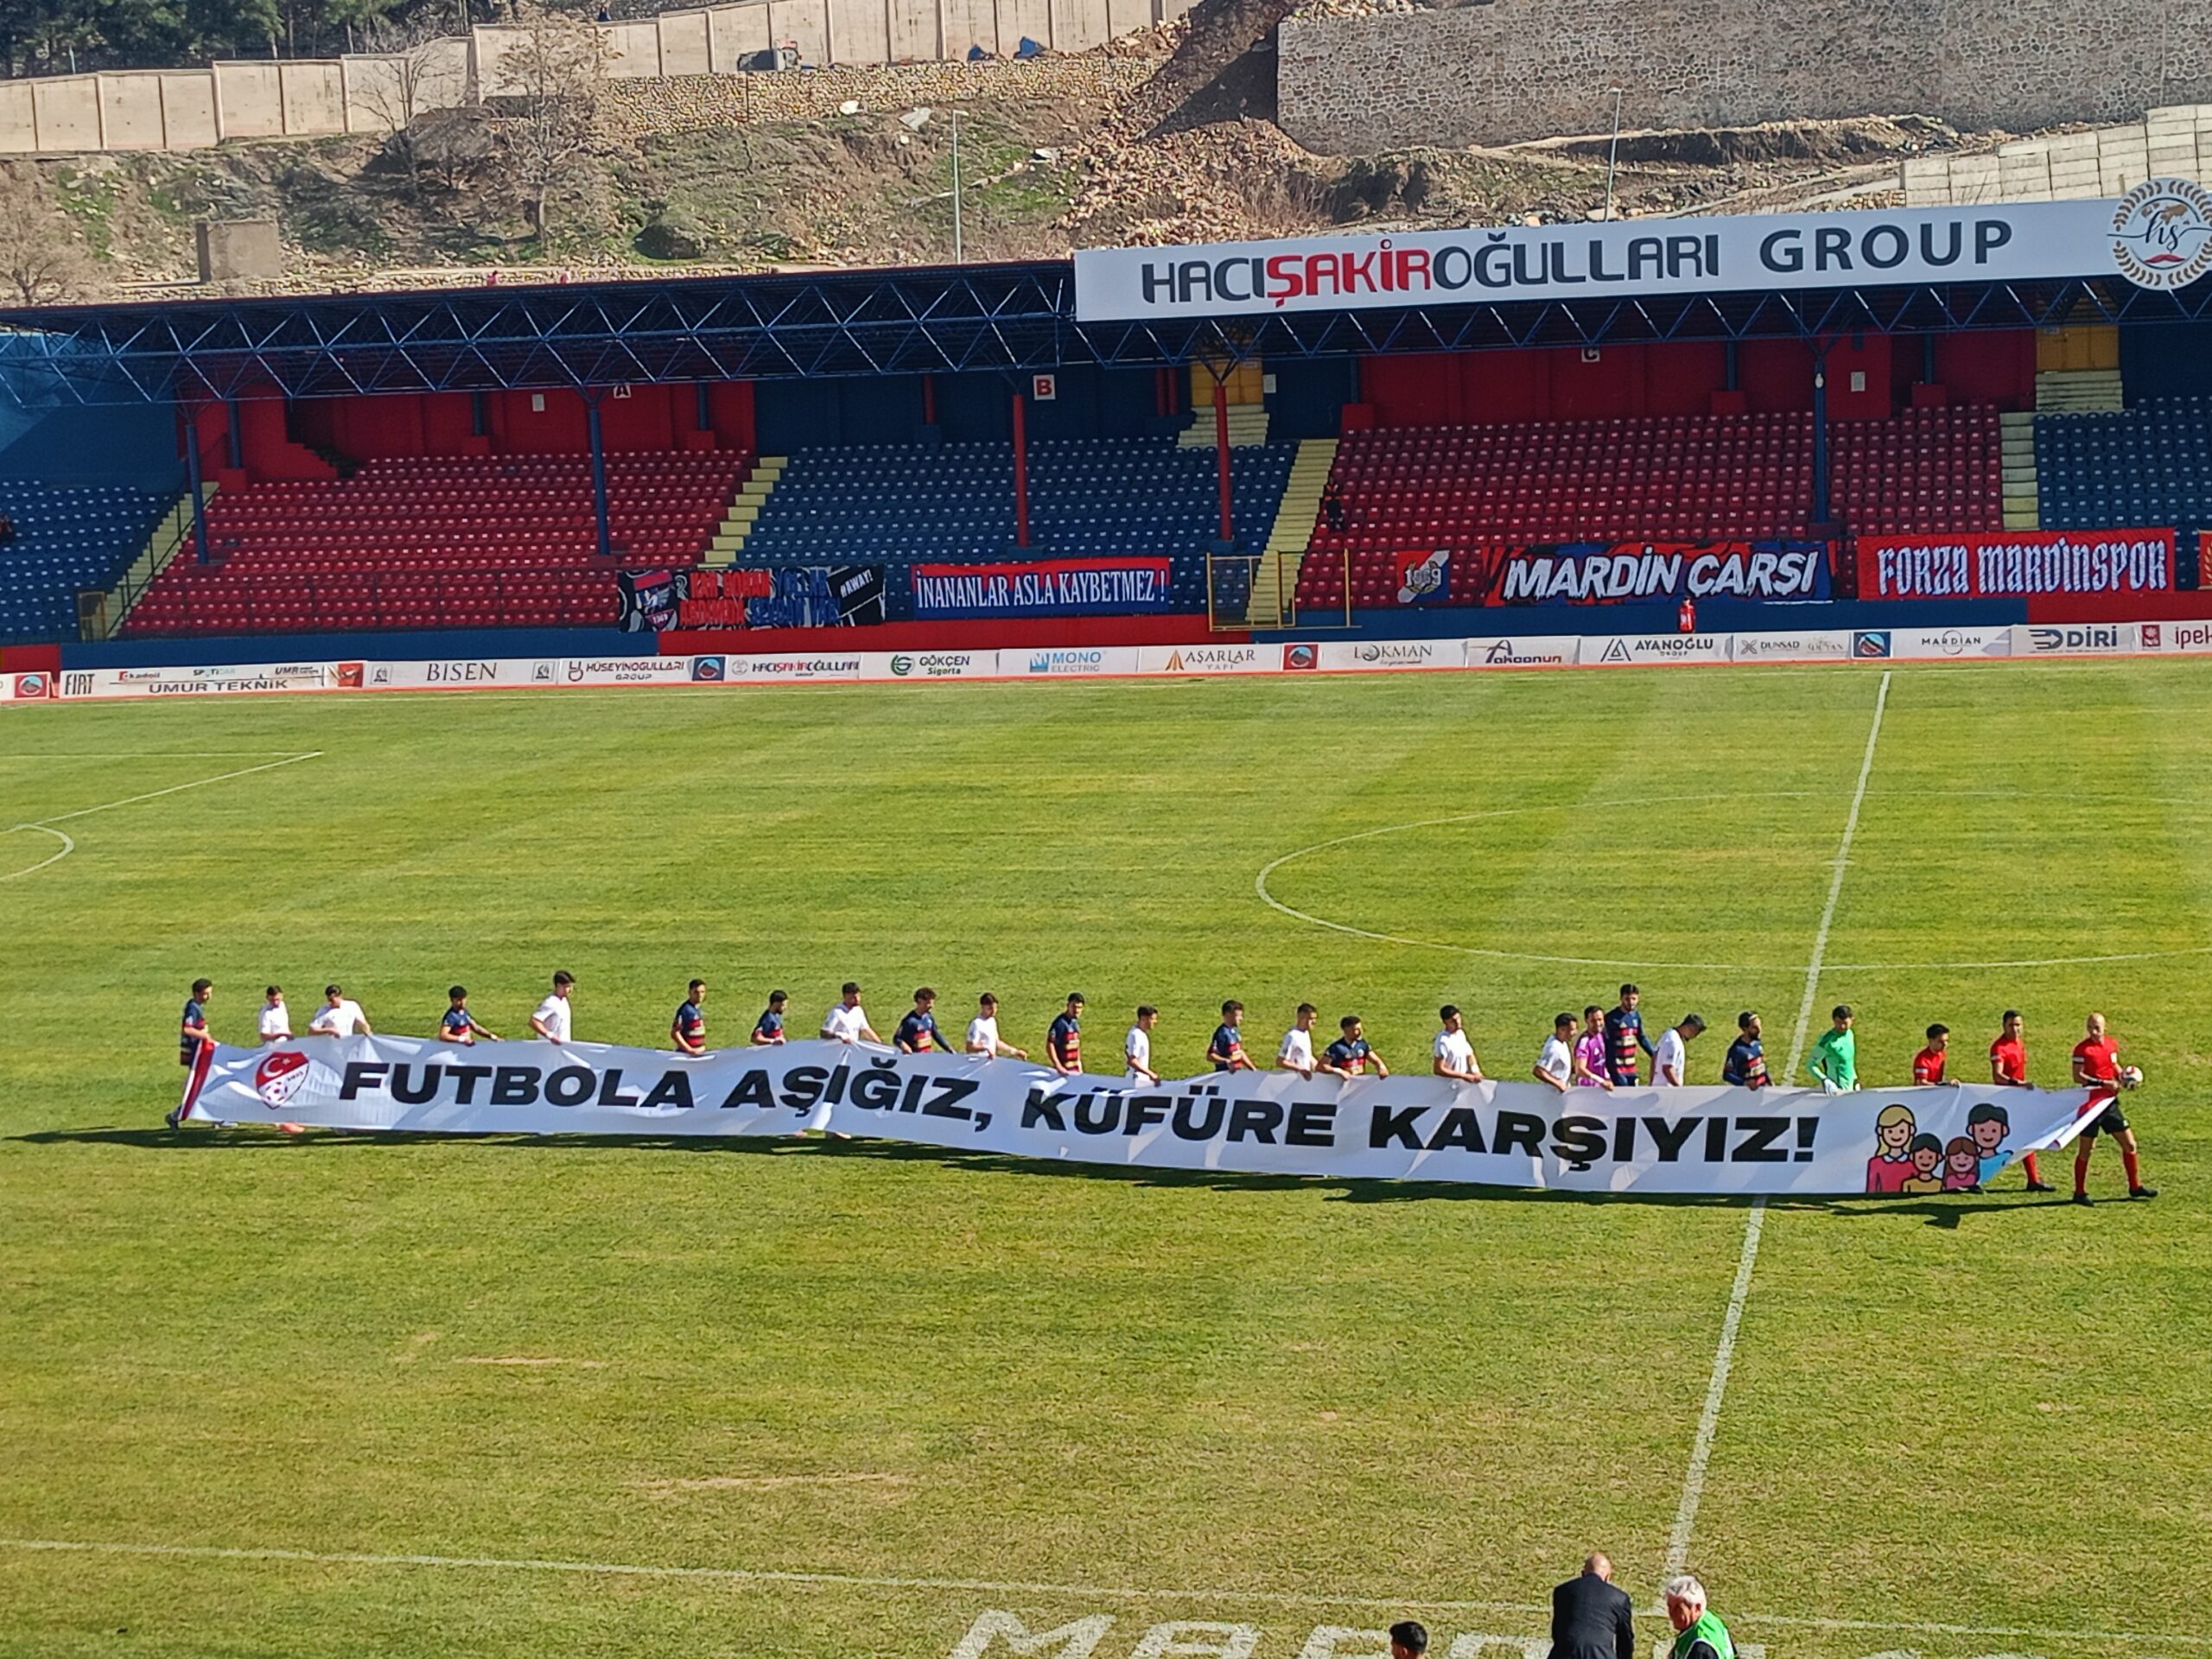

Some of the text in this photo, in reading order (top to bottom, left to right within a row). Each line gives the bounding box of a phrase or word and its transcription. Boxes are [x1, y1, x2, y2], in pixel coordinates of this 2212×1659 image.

[1141, 220, 2012, 308] HACIŞAKİROĞULLARI GROUP
[1037, 379, 1052, 396] B
[1503, 546, 1681, 600] MARDİN
[916, 569, 1008, 607] İNANANLAR
[1014, 574, 1055, 605] ASLA
[1052, 652, 1102, 664] MONO
[65, 674, 95, 695] FIAT
[149, 683, 207, 694] UMUR
[340, 1056, 1820, 1171] FUTBOLA AŞIĞIZ, KÜFÜRE KARŞIYIZ!
